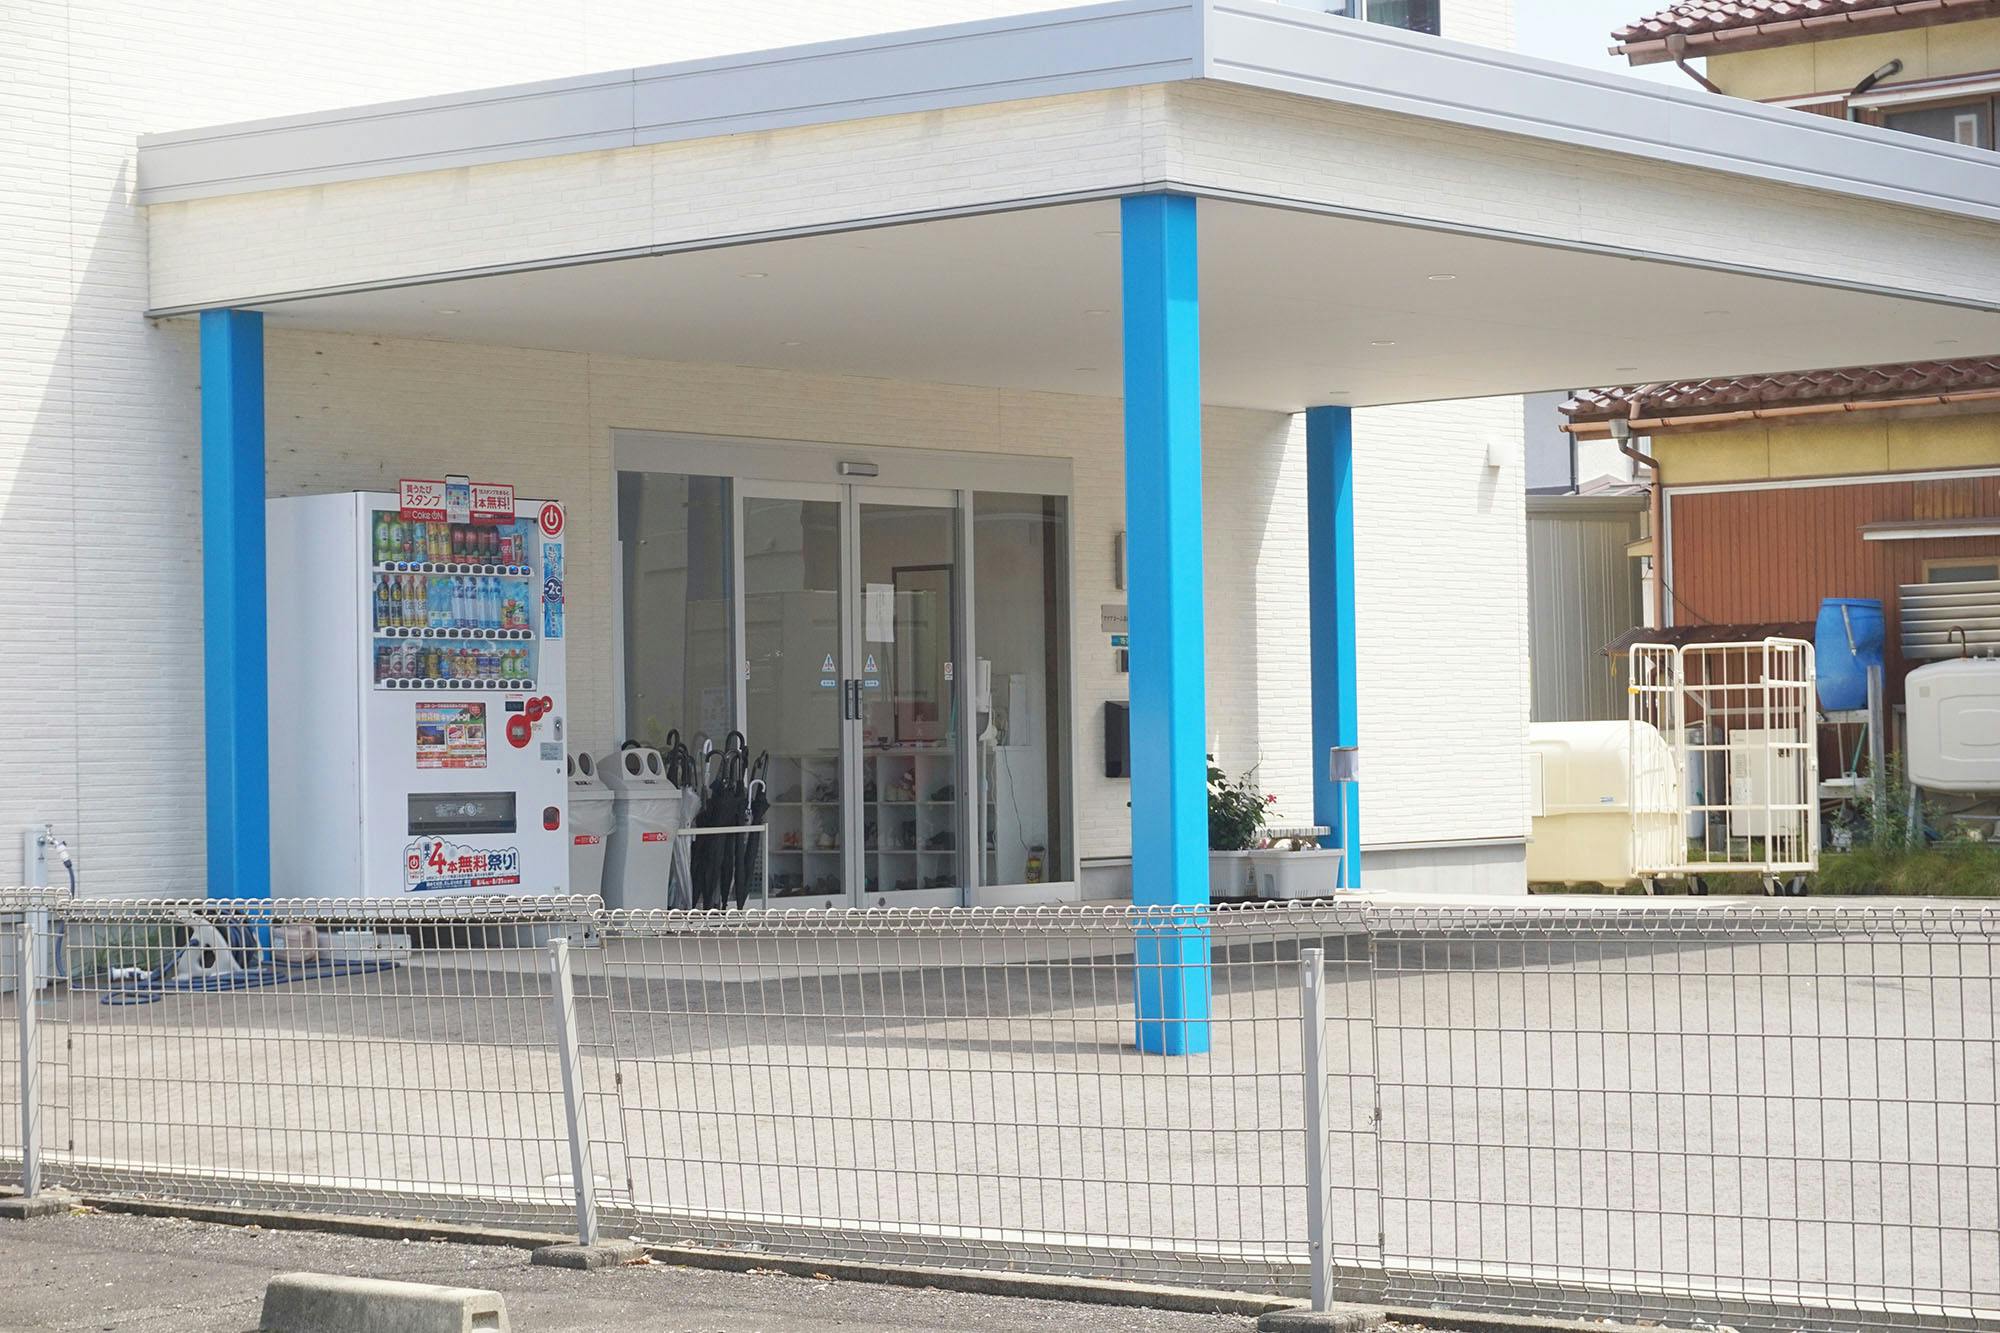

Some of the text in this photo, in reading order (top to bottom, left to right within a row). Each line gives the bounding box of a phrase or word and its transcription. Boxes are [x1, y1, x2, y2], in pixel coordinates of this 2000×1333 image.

[406, 484, 432, 495] 買うたび
[406, 493, 442, 507] スタンプ
[411, 510, 431, 520] Coke
